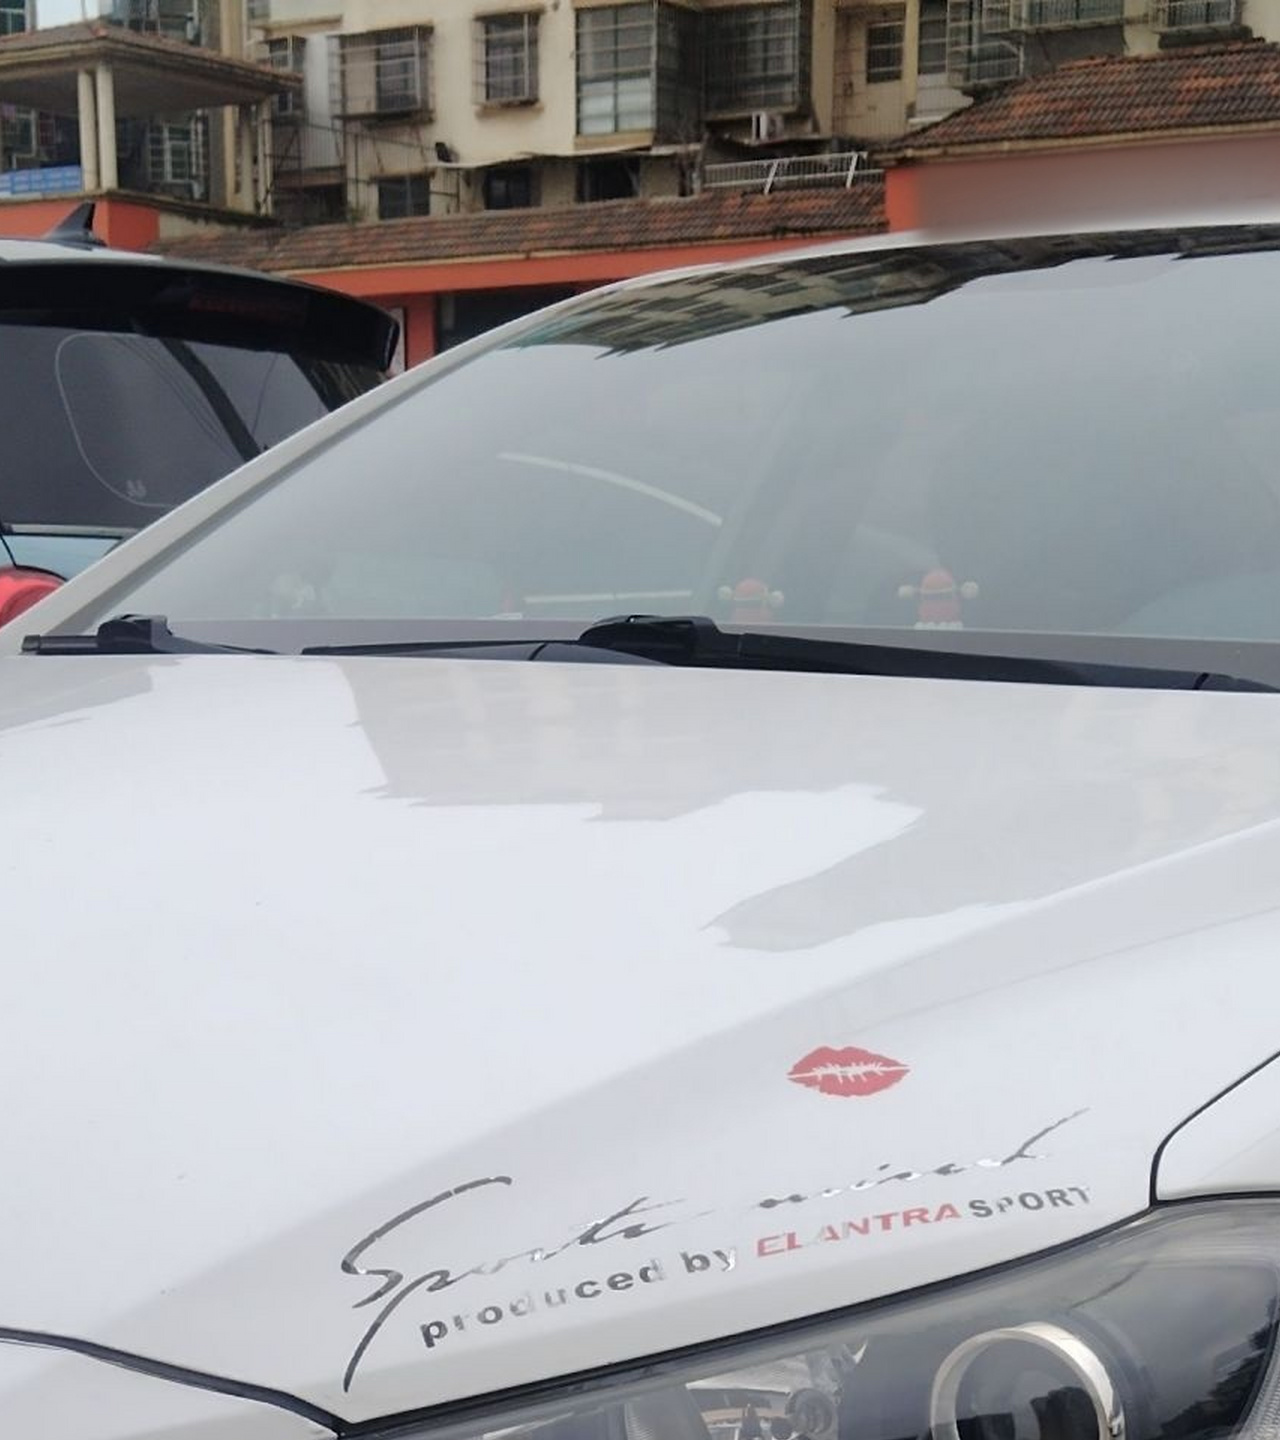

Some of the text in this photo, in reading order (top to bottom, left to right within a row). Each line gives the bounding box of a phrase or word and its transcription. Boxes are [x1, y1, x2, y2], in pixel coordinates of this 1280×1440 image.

[419, 1185, 1092, 1348] produced by ELANTRA SPORT
